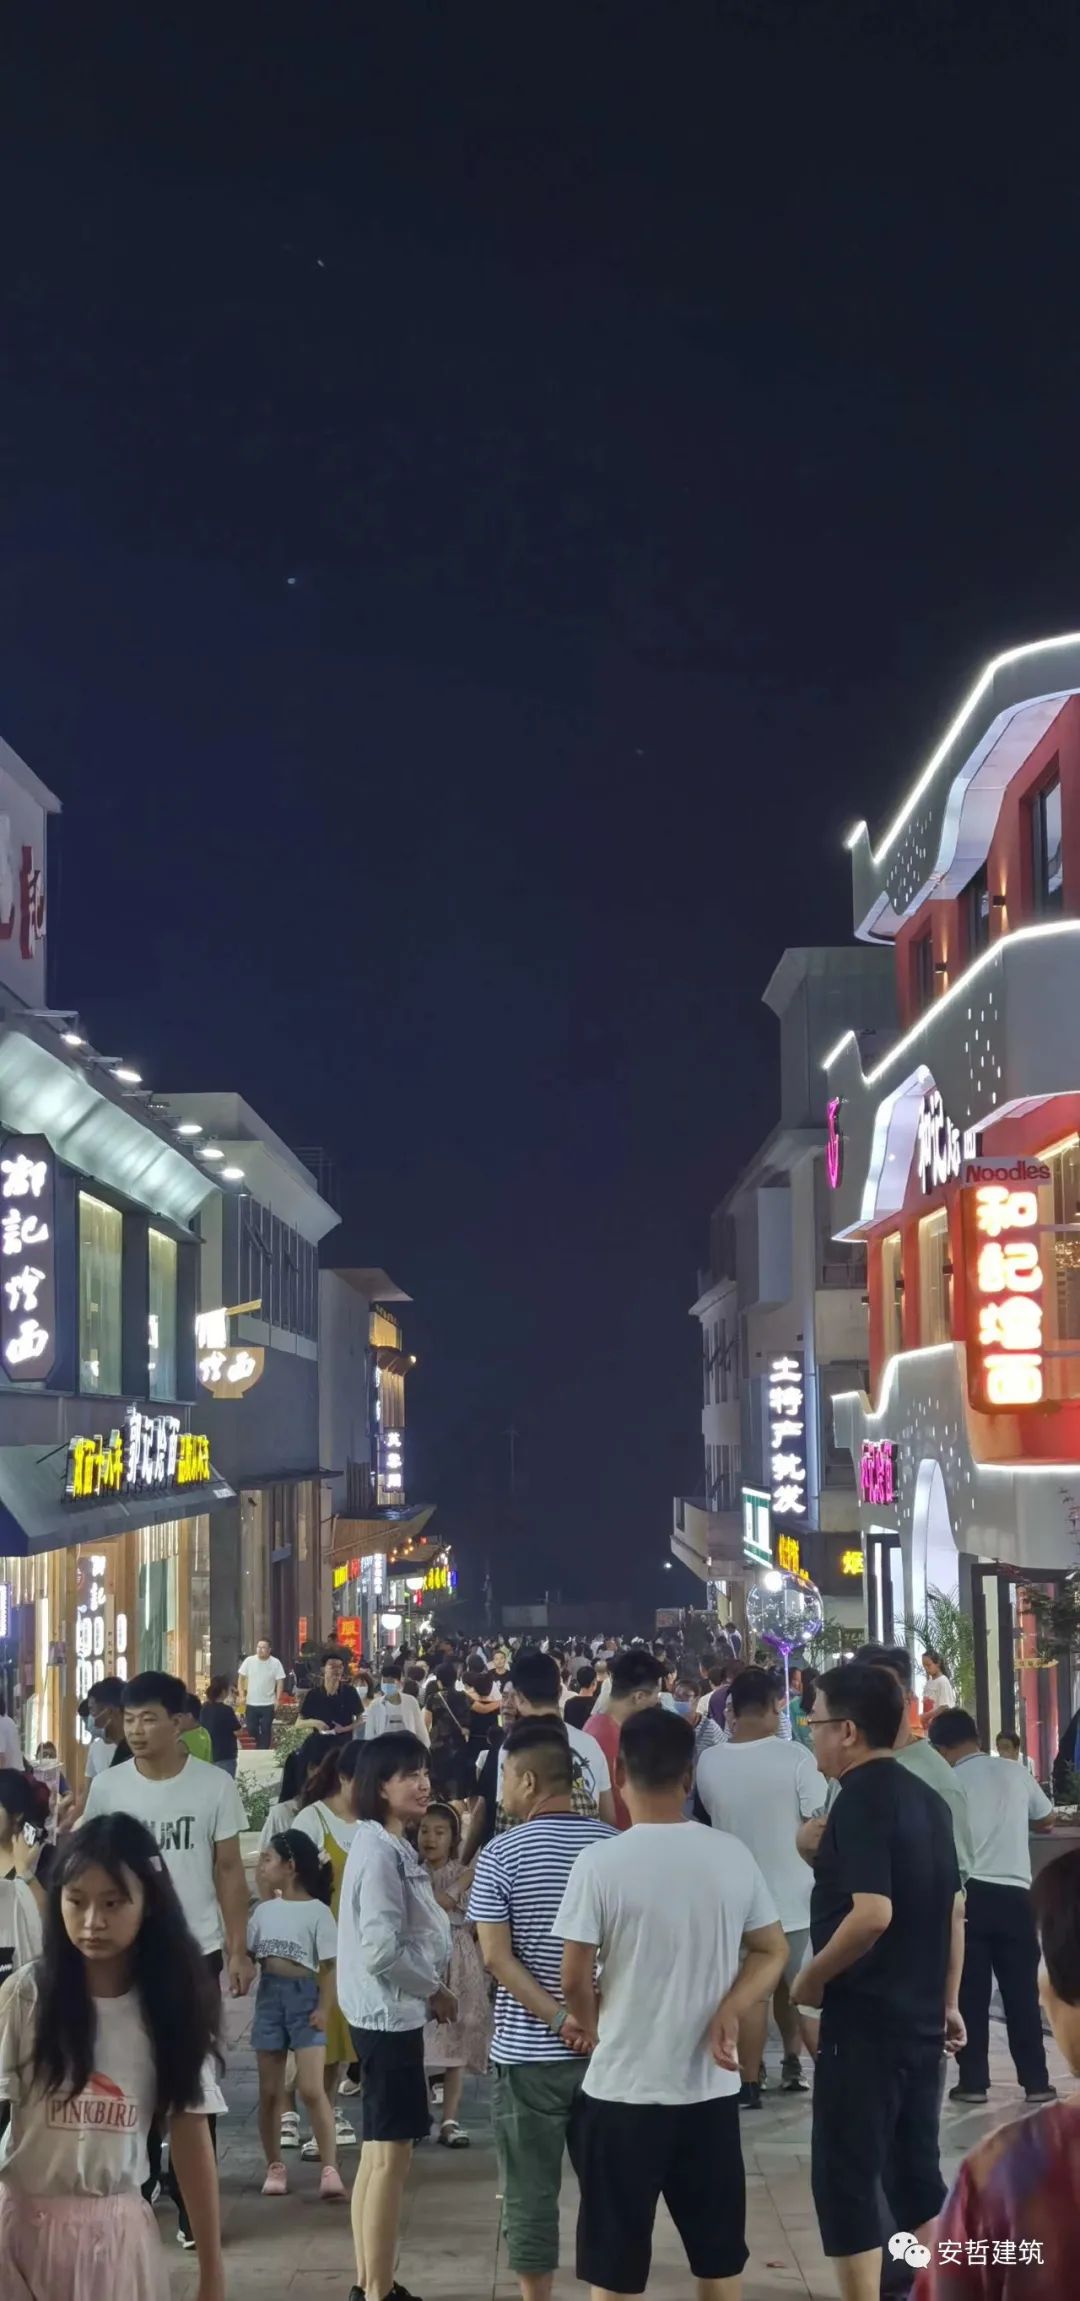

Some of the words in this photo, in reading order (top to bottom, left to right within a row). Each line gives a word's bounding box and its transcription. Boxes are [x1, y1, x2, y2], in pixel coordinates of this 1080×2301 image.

[966, 1161, 1050, 1183] Noodles
[769, 1356, 806, 1514] 土特产批发
[51, 2099, 139, 2128] PINKBIRD
